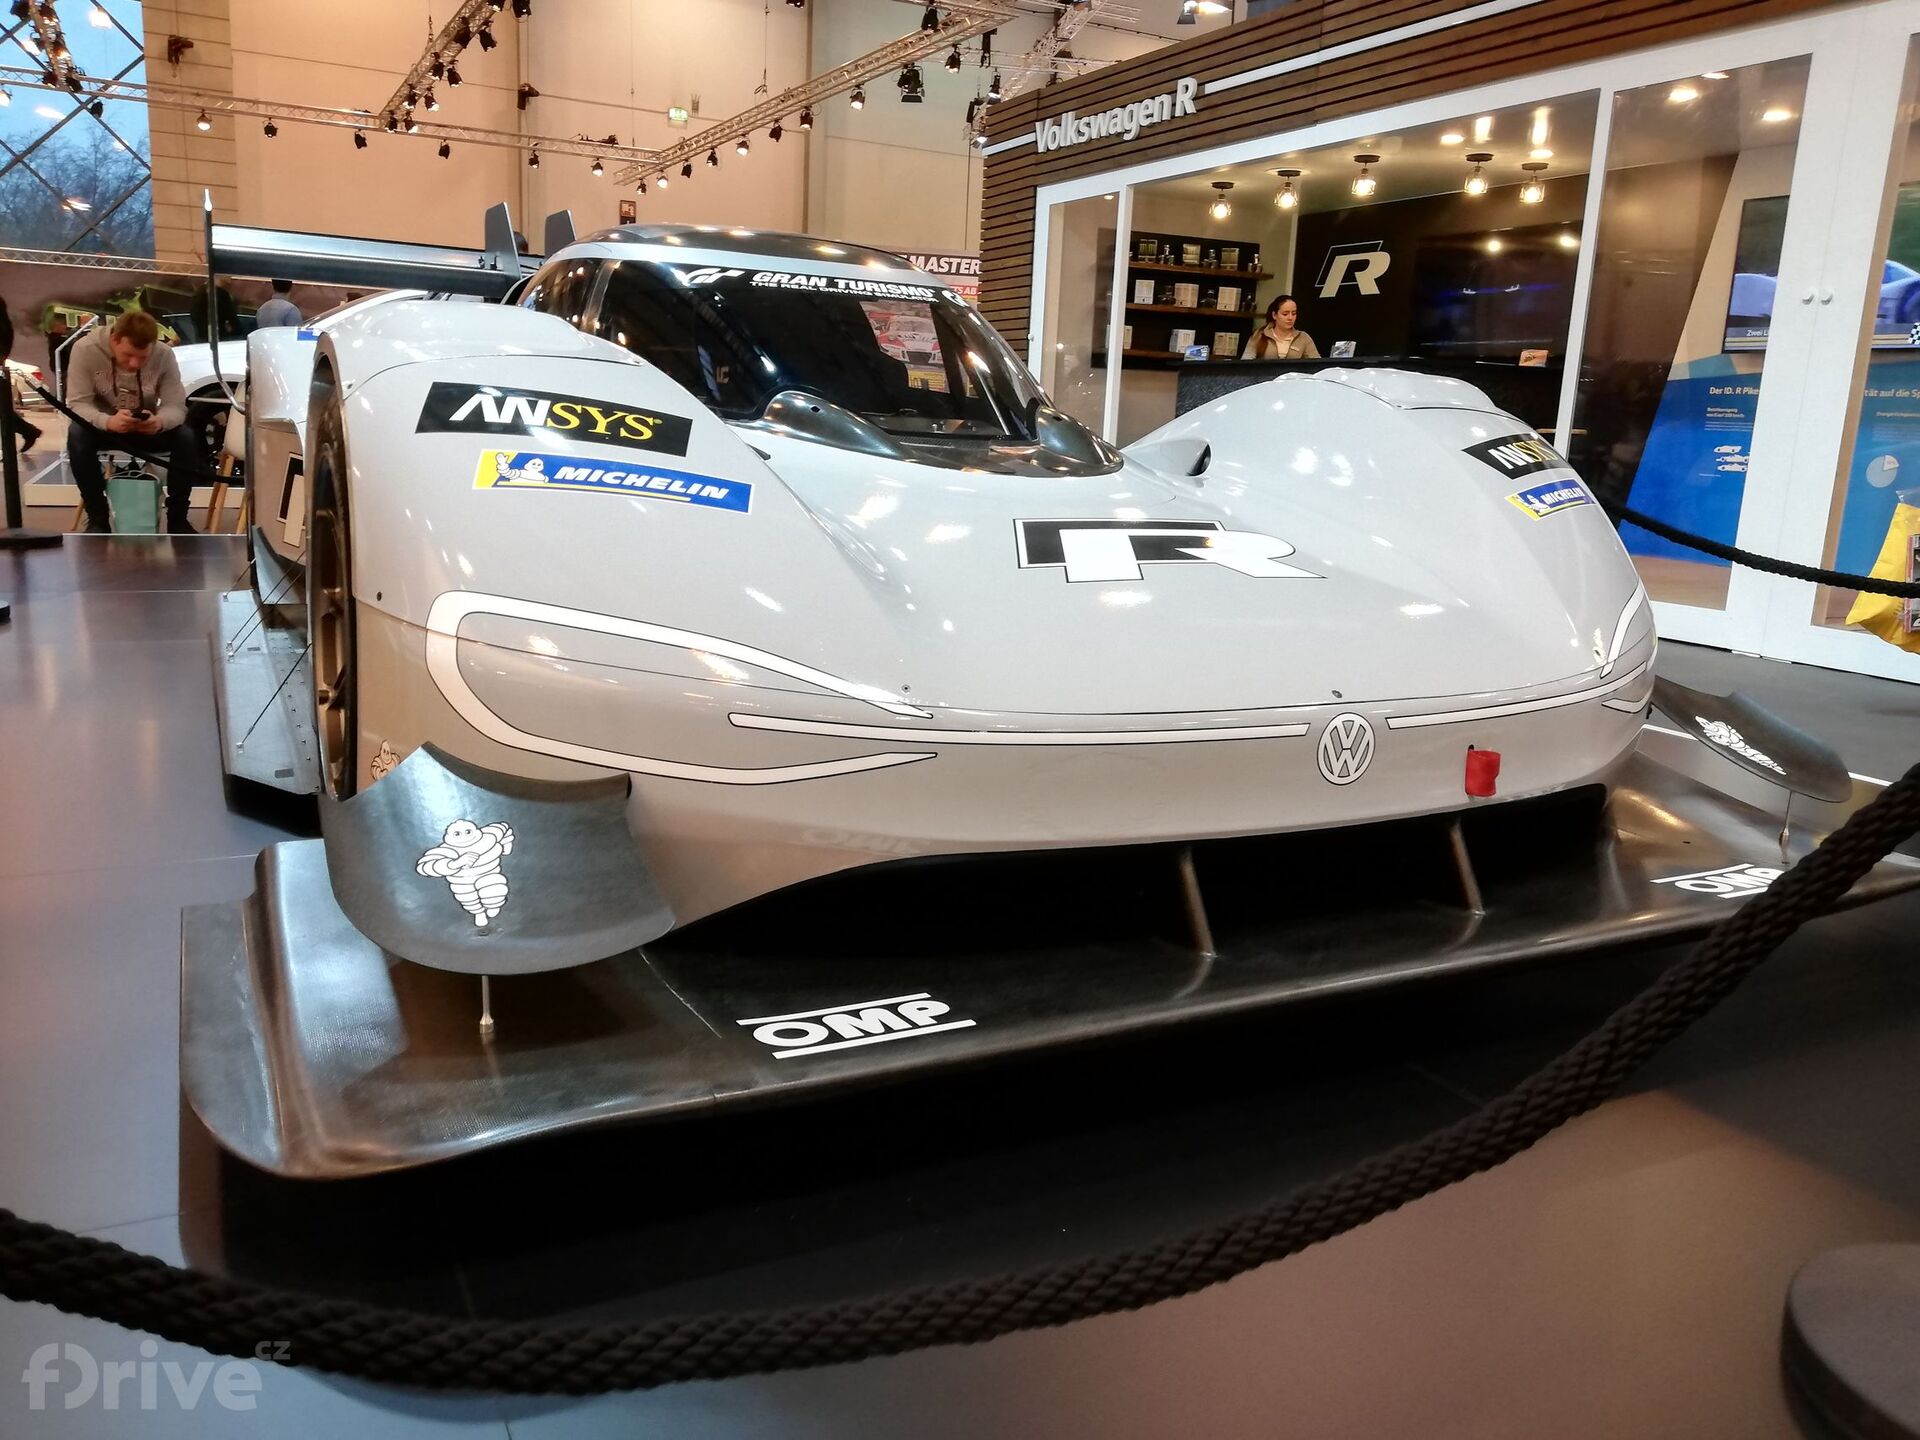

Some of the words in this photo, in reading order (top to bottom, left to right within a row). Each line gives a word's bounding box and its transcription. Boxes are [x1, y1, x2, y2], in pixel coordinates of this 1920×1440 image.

[1035, 93, 1172, 153] Volkswagen
[1174, 77, 1198, 117] R
[749, 281, 778, 289] THE
[780, 283, 818, 291] REAL
[819, 286, 873, 297] DRIVING
[751, 271, 828, 287] GRAN
[833, 278, 935, 298] TURISMO
[1709, 386, 1724, 395] Der
[449, 393, 655, 441] ANSYS
[1487, 439, 1559, 470] ANSYS
[553, 465, 730, 500] MICHELIN
[1540, 486, 1586, 504] MICHELIN
[1675, 867, 1785, 893] OMP
[753, 1000, 951, 1047] OMP
